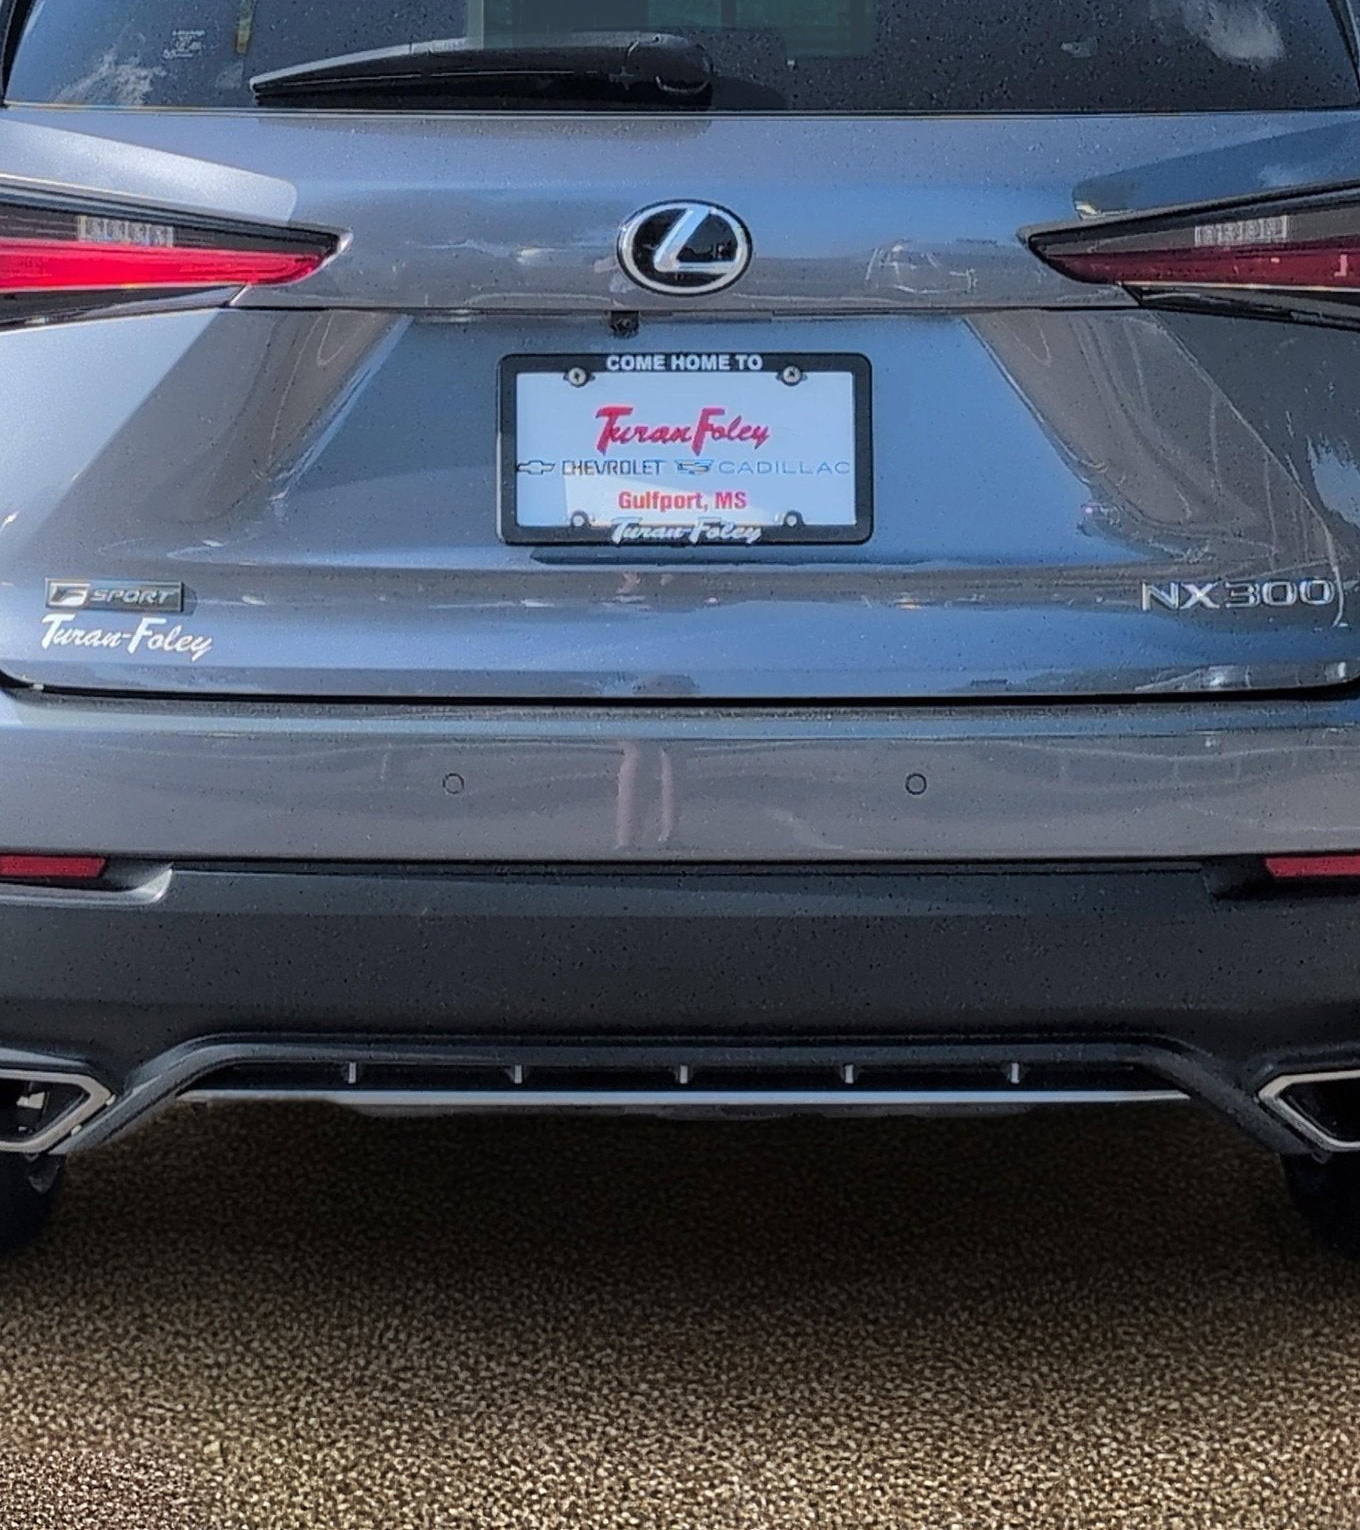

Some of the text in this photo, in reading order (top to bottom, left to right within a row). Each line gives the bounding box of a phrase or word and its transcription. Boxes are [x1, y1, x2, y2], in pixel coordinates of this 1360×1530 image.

[606, 354, 763, 371] COME HOME TO
[561, 460, 851, 476] CHEVROLET CADILLAC
[618, 490, 748, 512] Gulfport, MS
[91, 588, 177, 605] SPORT
